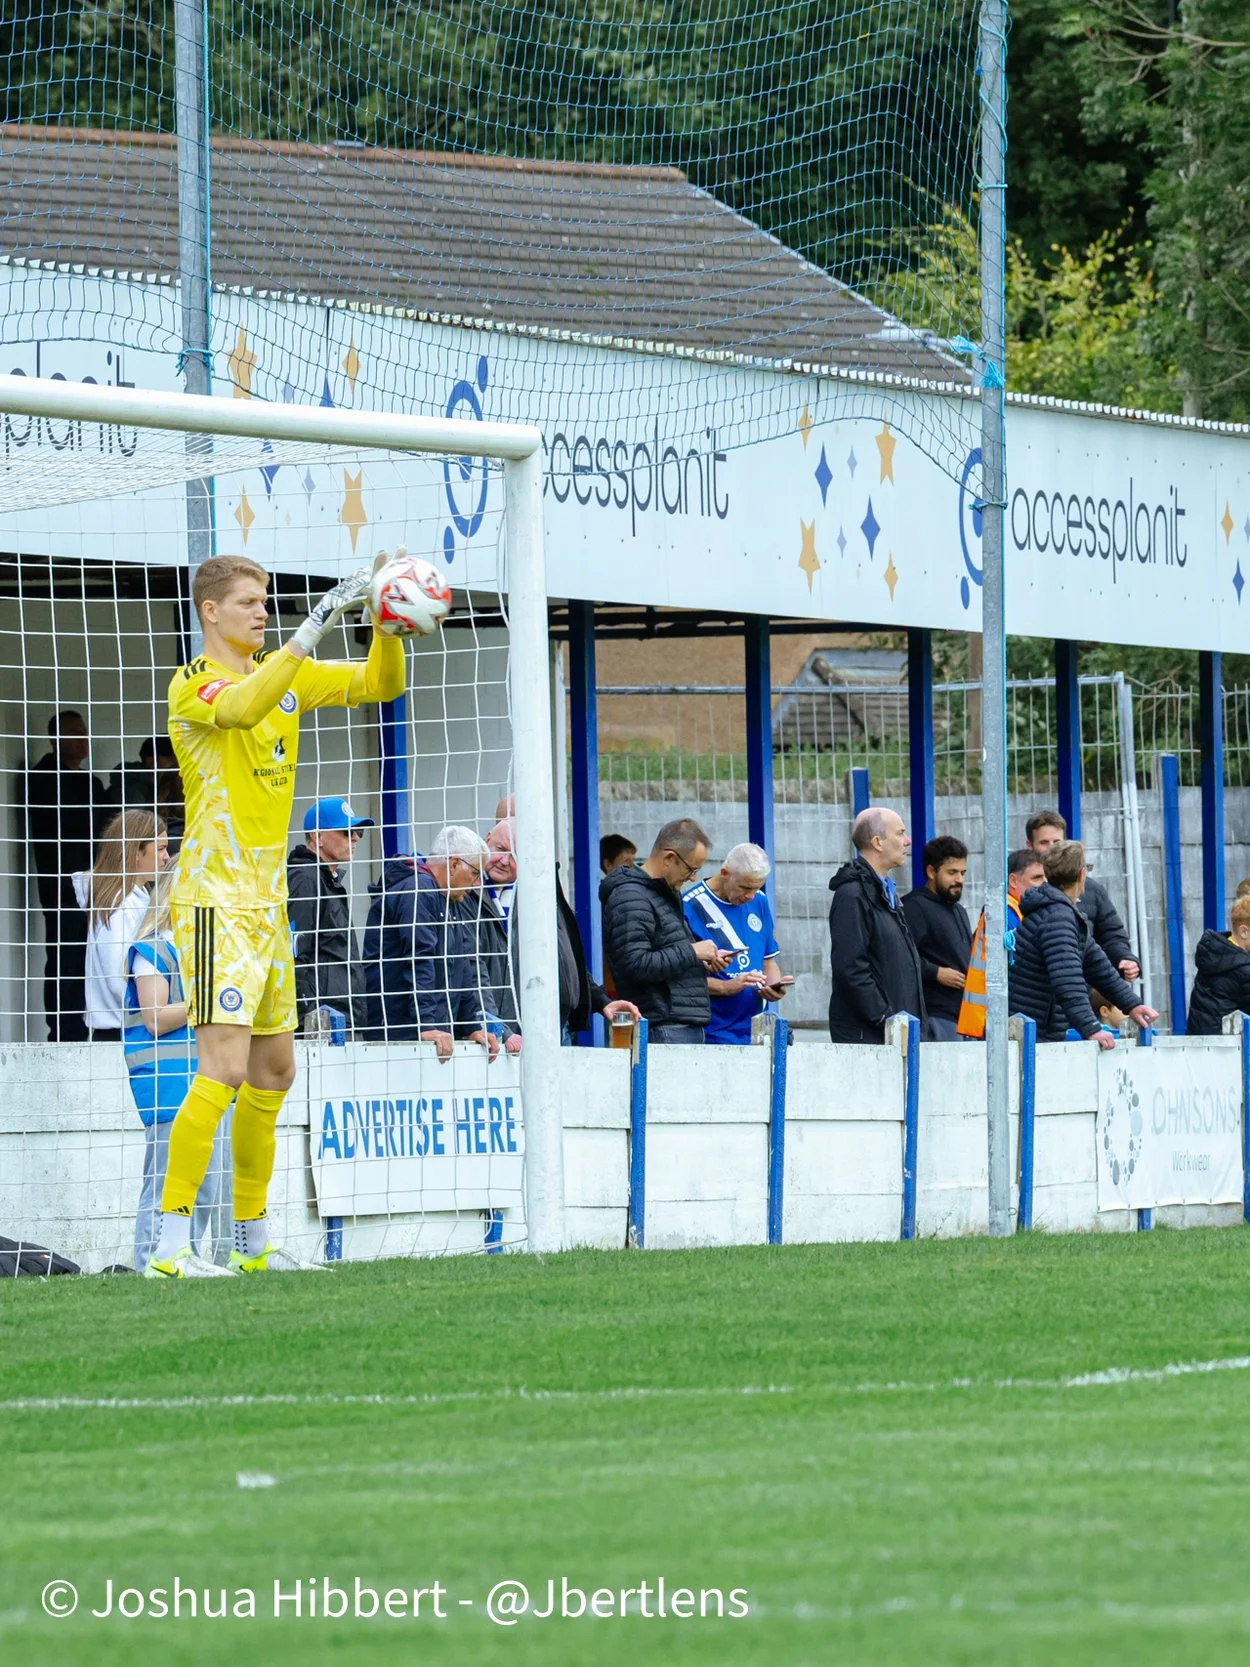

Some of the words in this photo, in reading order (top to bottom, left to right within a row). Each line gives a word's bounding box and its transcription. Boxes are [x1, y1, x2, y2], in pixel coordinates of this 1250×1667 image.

[1011, 477, 1187, 584] accessplanit
[317, 1098, 445, 1159] ADVERTISE
[453, 1097, 517, 1154] HERE
